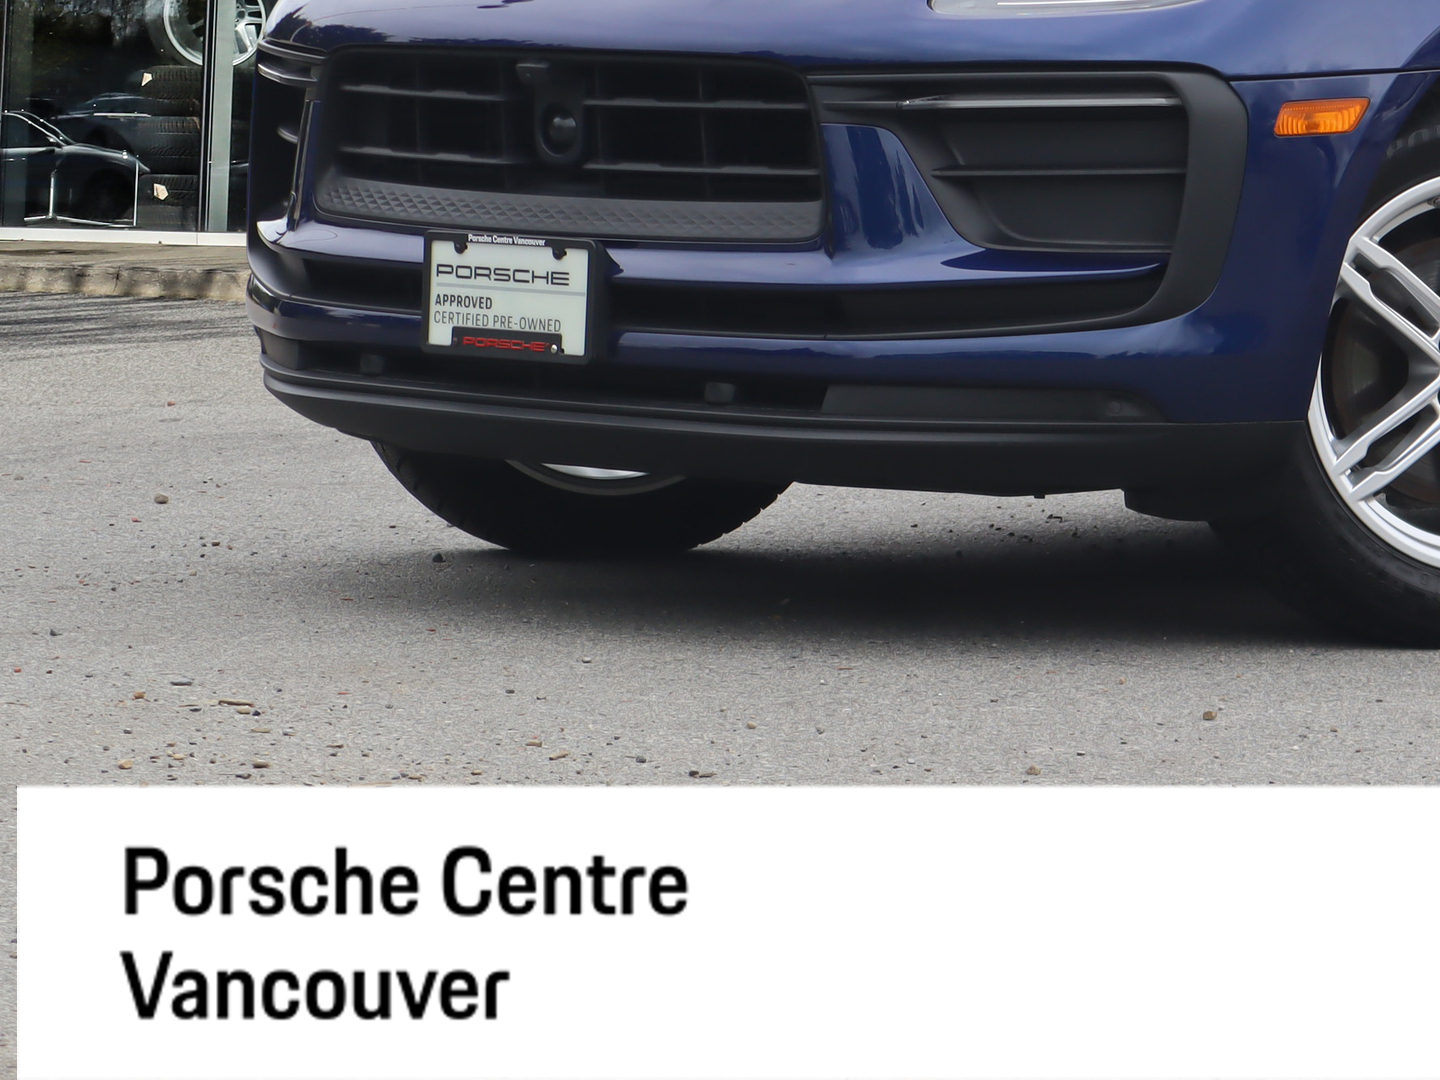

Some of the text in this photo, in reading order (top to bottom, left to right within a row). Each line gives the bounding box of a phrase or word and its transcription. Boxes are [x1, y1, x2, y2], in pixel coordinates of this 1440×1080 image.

[468, 233, 546, 246] Porsche Centre Vancouver
[436, 264, 570, 286] PORSCHE
[434, 293, 493, 310] APPROVED
[433, 310, 562, 333] CERTIFIED PRE-OWNED
[462, 336, 546, 352] PORSCHE
